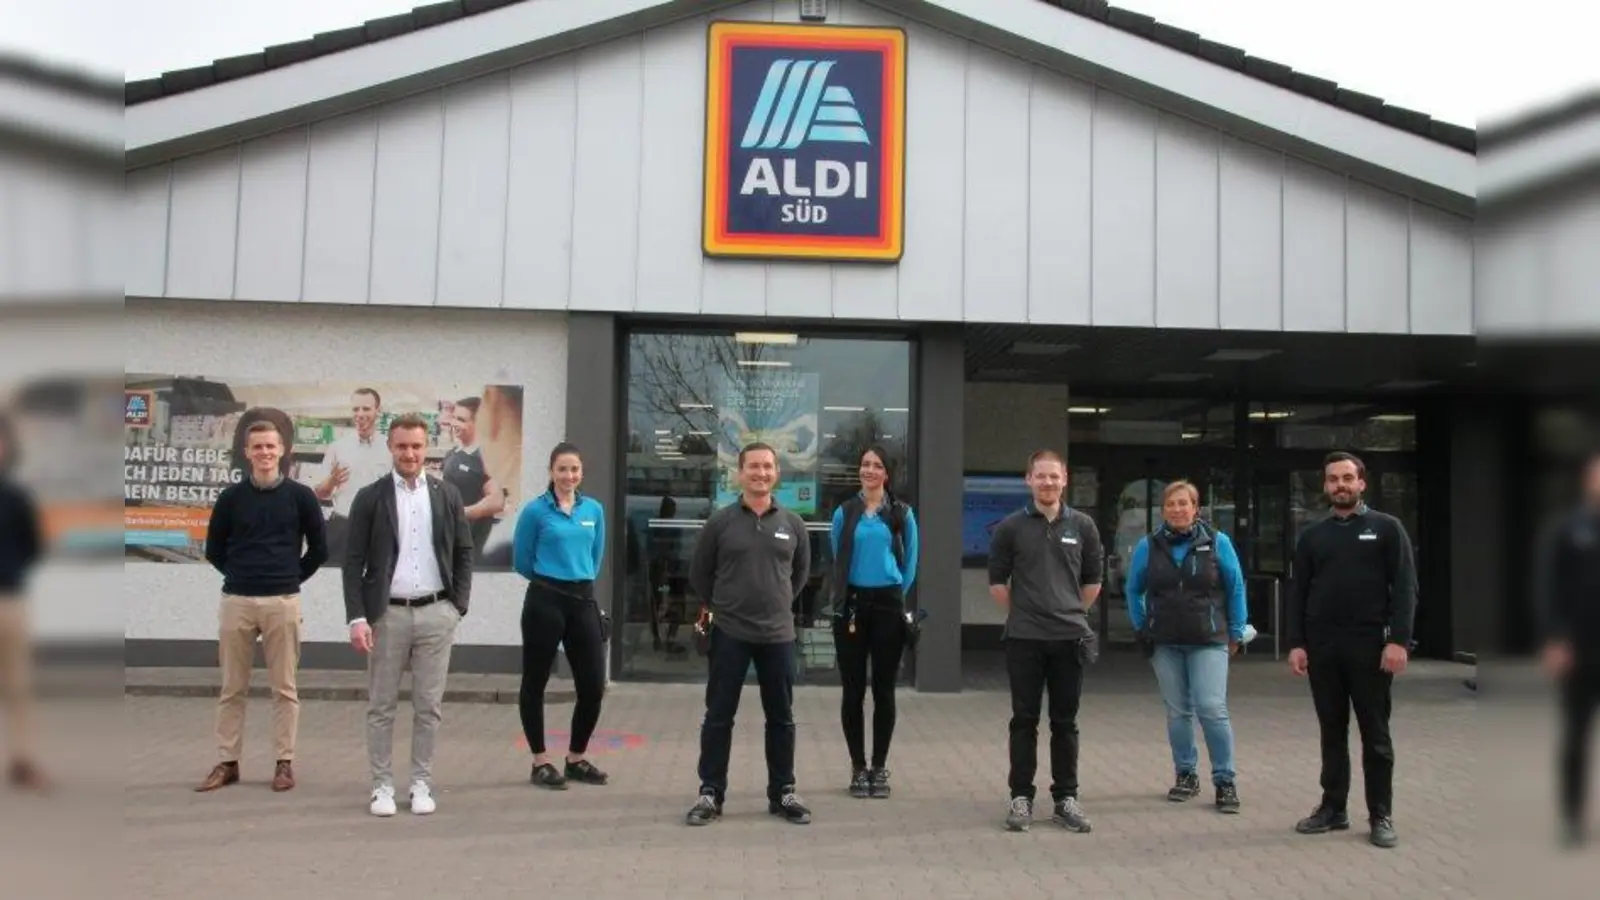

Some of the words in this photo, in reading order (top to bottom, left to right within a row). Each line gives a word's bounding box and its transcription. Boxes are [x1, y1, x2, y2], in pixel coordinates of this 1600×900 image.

[740, 158, 868, 198] ALDI
[781, 199, 828, 223] SÜD
[182, 448, 229, 463] GEBE
[150, 467, 205, 483] JEDEN
[209, 468, 242, 484] TAG
